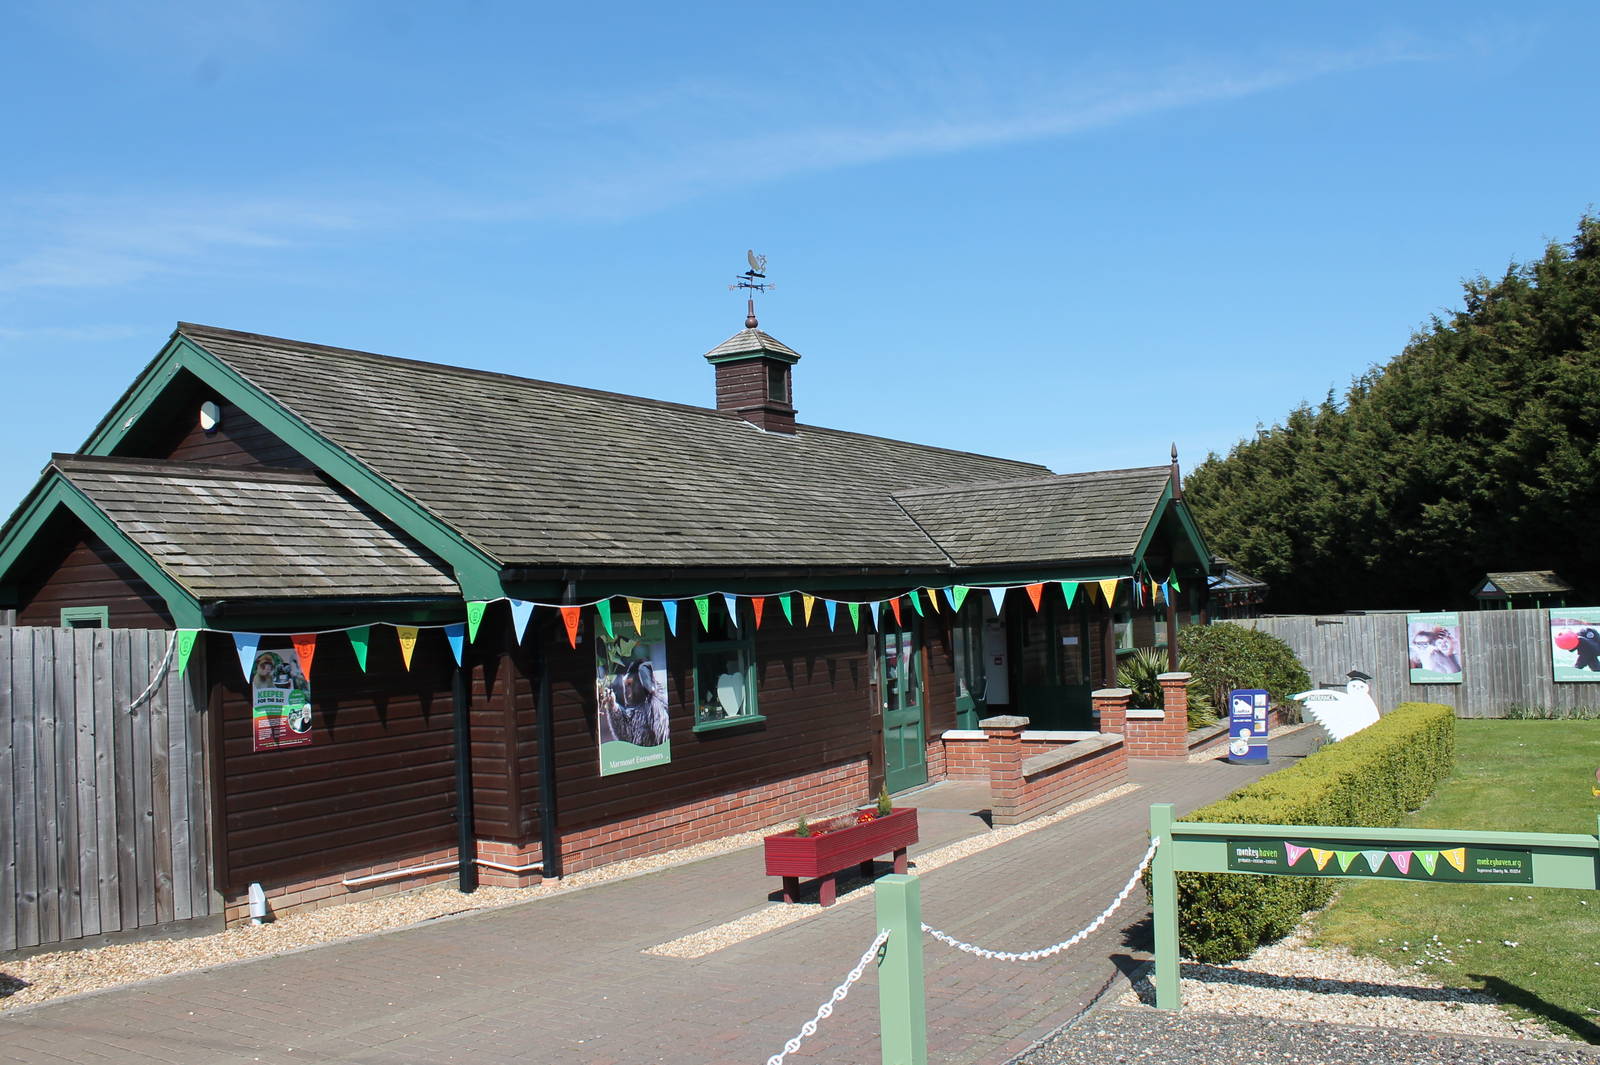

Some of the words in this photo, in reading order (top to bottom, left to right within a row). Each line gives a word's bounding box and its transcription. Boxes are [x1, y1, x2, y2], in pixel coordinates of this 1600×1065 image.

[257, 690, 284, 698] KEEPER
[609, 757, 635, 769] Marmoset
[635, 753, 664, 764] Encounters
[1476, 857, 1522, 868] monkeyhaven.org
